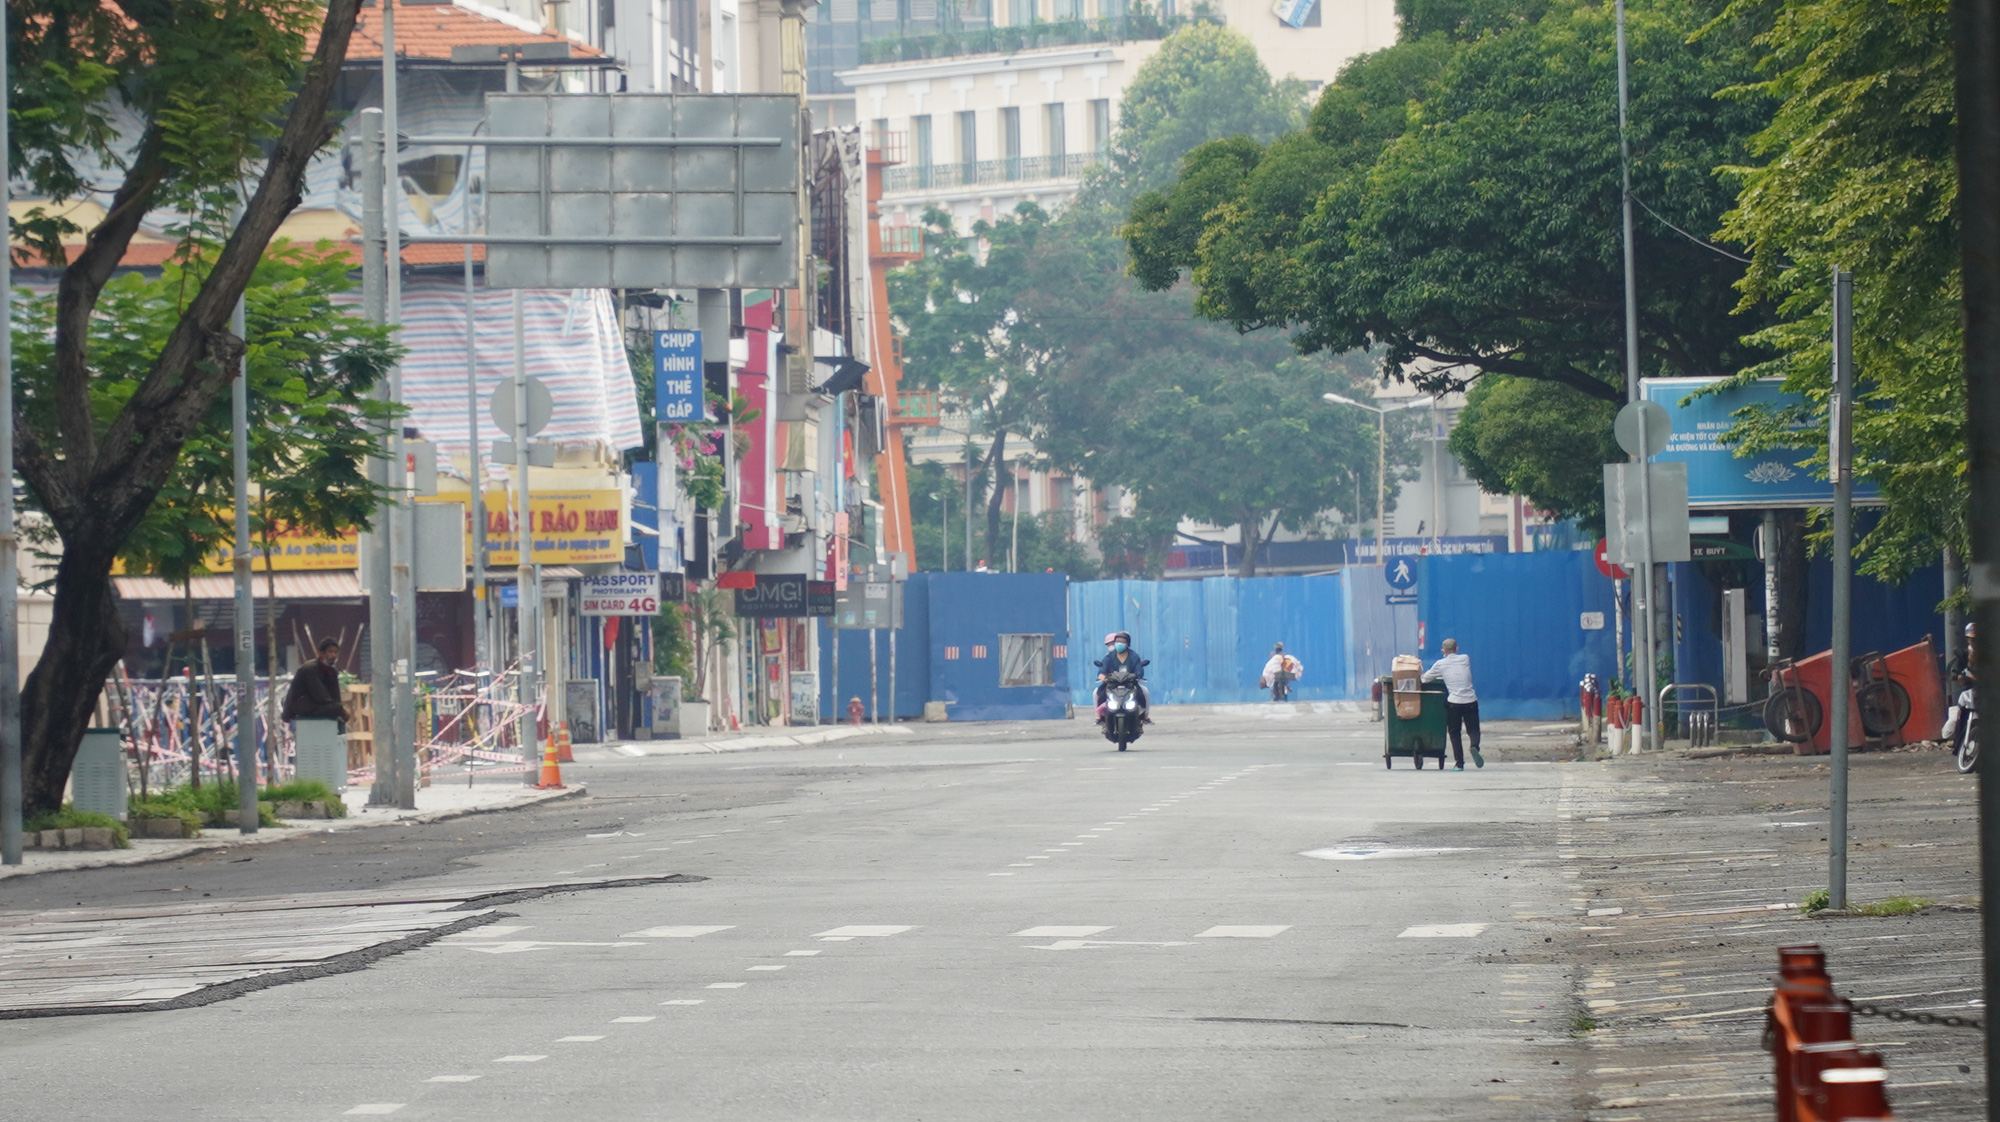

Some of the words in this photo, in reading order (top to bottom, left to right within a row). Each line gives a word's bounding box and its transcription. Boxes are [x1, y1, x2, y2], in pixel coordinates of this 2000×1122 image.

[660, 333, 696, 352] CHỤP
[663, 353, 695, 372] HÌNH
[666, 374, 693, 395] THẺ
[666, 398, 694, 418] GẤP
[1697, 421, 1715, 430] NHÂN
[541, 503, 580, 532] BẢO
[585, 509, 619, 535] HẠNH
[1693, 548, 1703, 556] XE
[1706, 546, 1726, 555] BUÝT
[584, 574, 656, 587] PASSPORT
[742, 582, 802, 602] OMG!
[583, 599, 599, 611] SIM
[601, 599, 625, 611] CARD
[628, 597, 656, 612] 4G
